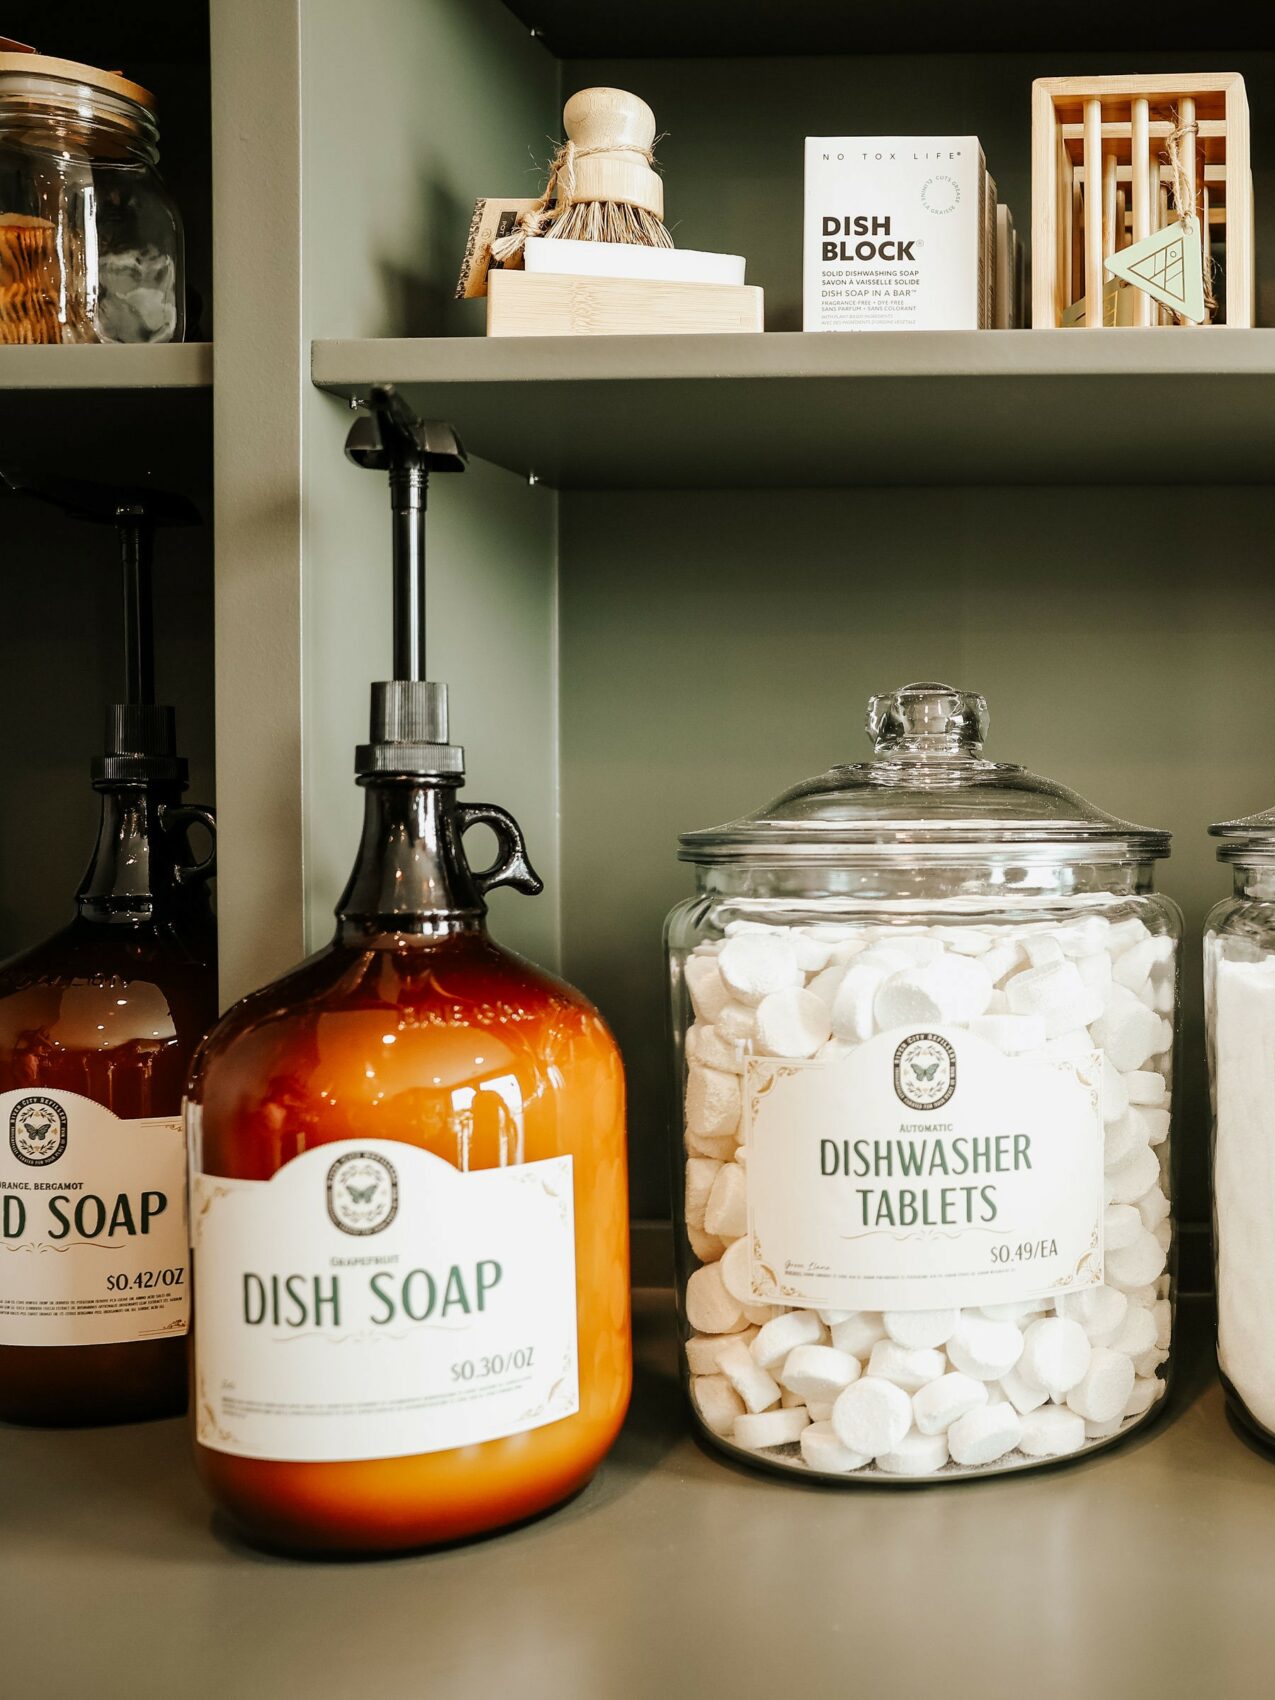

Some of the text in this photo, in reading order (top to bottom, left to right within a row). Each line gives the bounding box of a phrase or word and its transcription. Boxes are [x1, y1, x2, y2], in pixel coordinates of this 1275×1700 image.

[823, 153, 845, 161] NO
[862, 153, 896, 161] TOX
[822, 215, 891, 236] DISH
[821, 290, 843, 298] DISH
[845, 289, 870, 297] SOAP
[872, 289, 881, 297] IN
[884, 289, 891, 297] A
[819, 1133, 1034, 1178] DISHWASHER
[0, 1182, 84, 1191] RANGE, BERGAMOT
[48, 1191, 168, 1240] SOAP
[855, 1184, 999, 1227] TABLETS
[989, 1238, 1059, 1265] $0.49/EA
[106, 1267, 185, 1292] $0.42/OZ
[242, 1259, 504, 1328] DISH SOAP
[450, 1346, 536, 1383] $0.30/OZ
